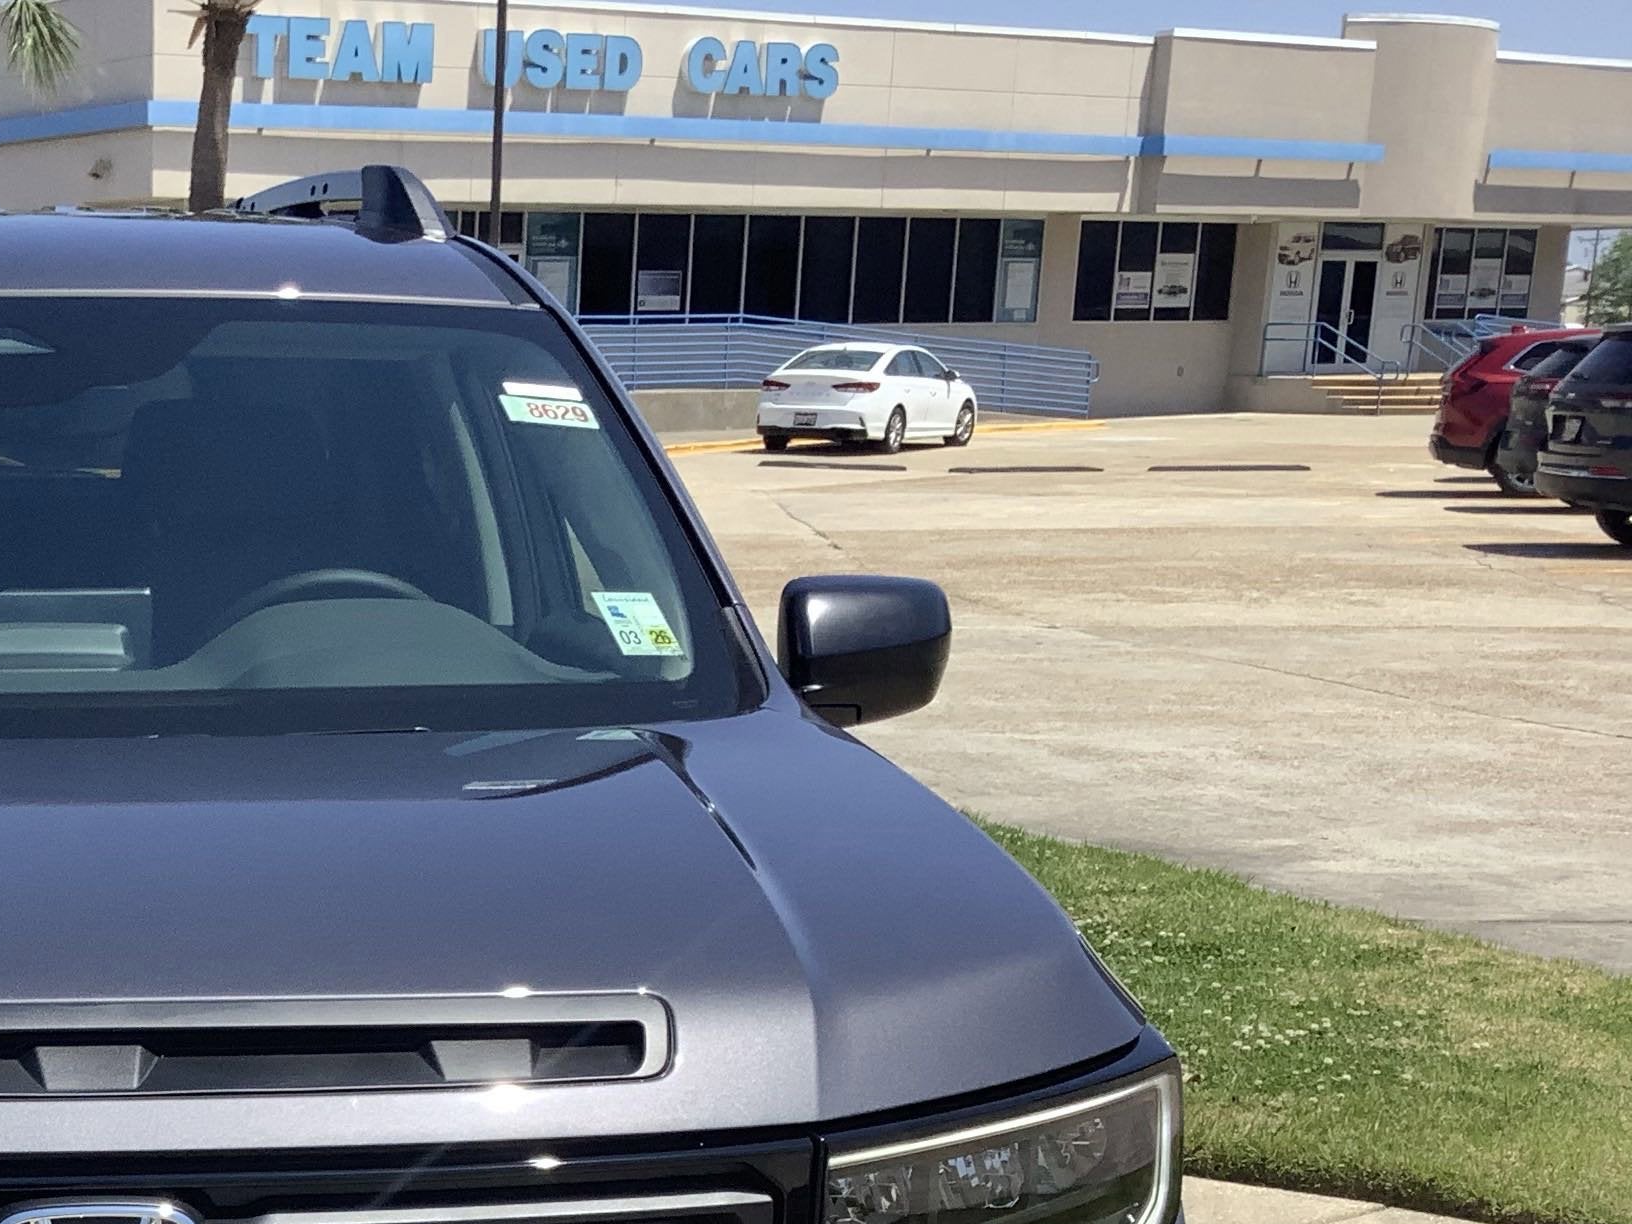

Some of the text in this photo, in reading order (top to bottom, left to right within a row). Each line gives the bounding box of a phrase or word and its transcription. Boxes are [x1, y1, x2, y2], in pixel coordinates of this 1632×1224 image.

[246, 14, 840, 100] TEAM USED CARS
[526, 401, 589, 423] 8629
[618, 630, 671, 645] 03 26
